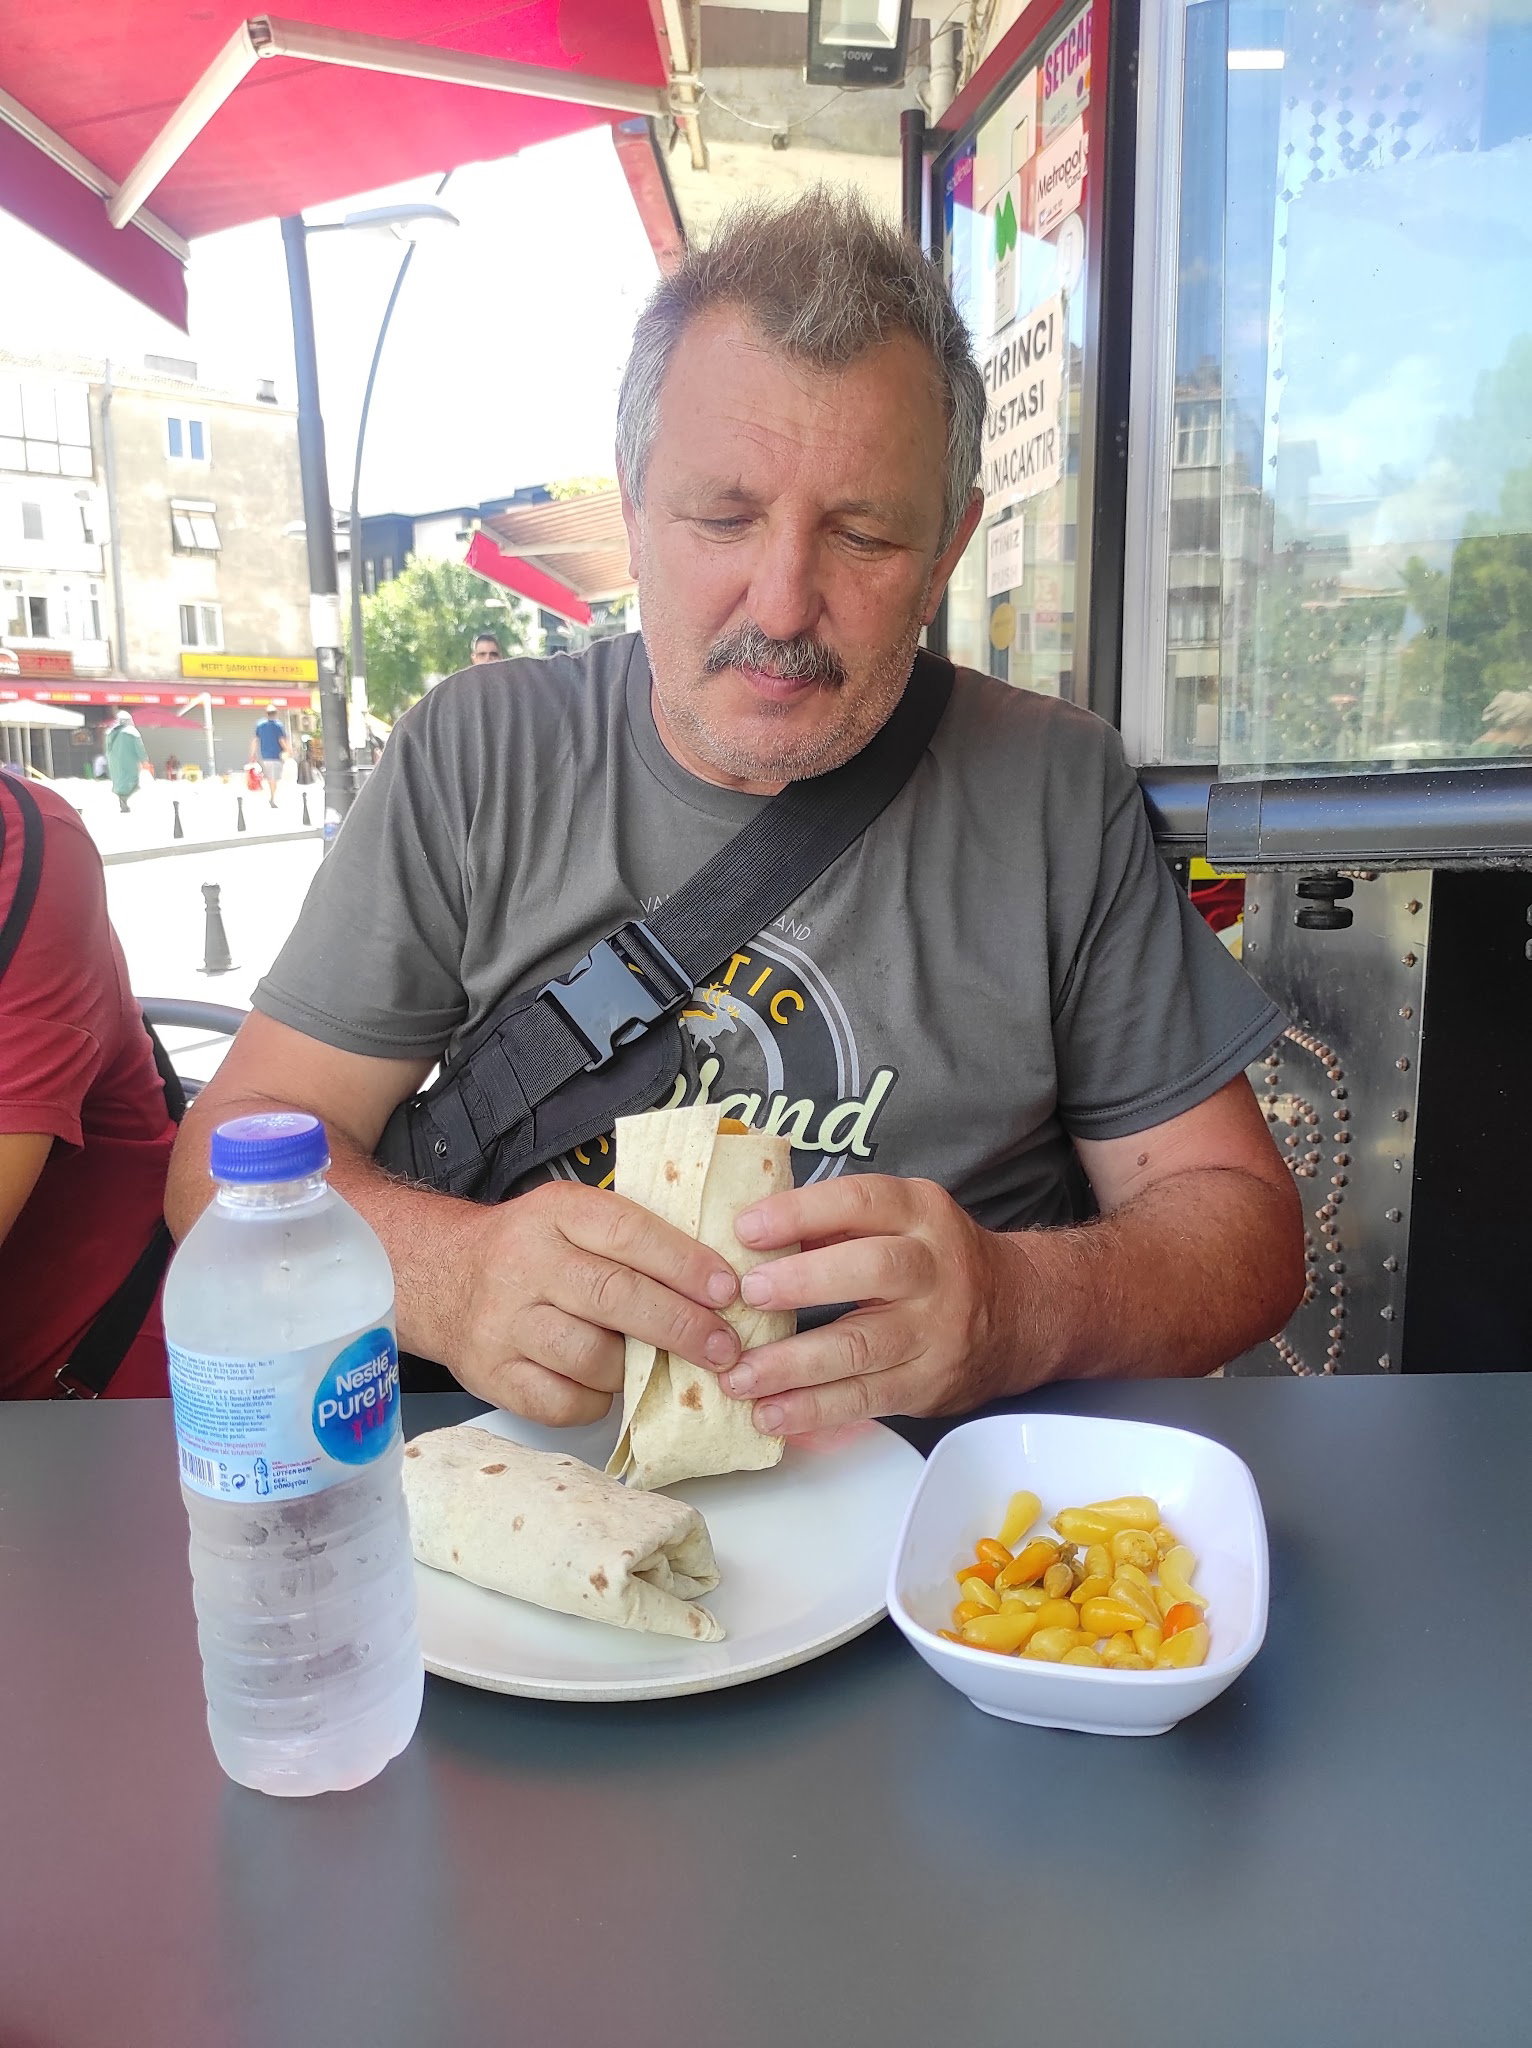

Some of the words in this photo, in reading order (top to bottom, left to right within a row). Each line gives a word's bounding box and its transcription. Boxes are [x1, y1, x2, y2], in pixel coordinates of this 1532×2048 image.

[841, 50, 874, 61] 100W
[1045, 8, 1092, 100] SETCAR
[1037, 140, 1082, 202] Metropol
[983, 312, 1055, 393] FIRINCI
[988, 380, 1045, 443] USTASI
[984, 427, 1055, 498] LINACAKTIR
[640, 895, 669, 914] VA
[769, 914, 811, 941] AND
[722, 953, 806, 1026] TIC
[318, 1386, 376, 1428] Pure
[378, 1364, 399, 1402] Life
[336, 1350, 390, 1396] Nestlé
